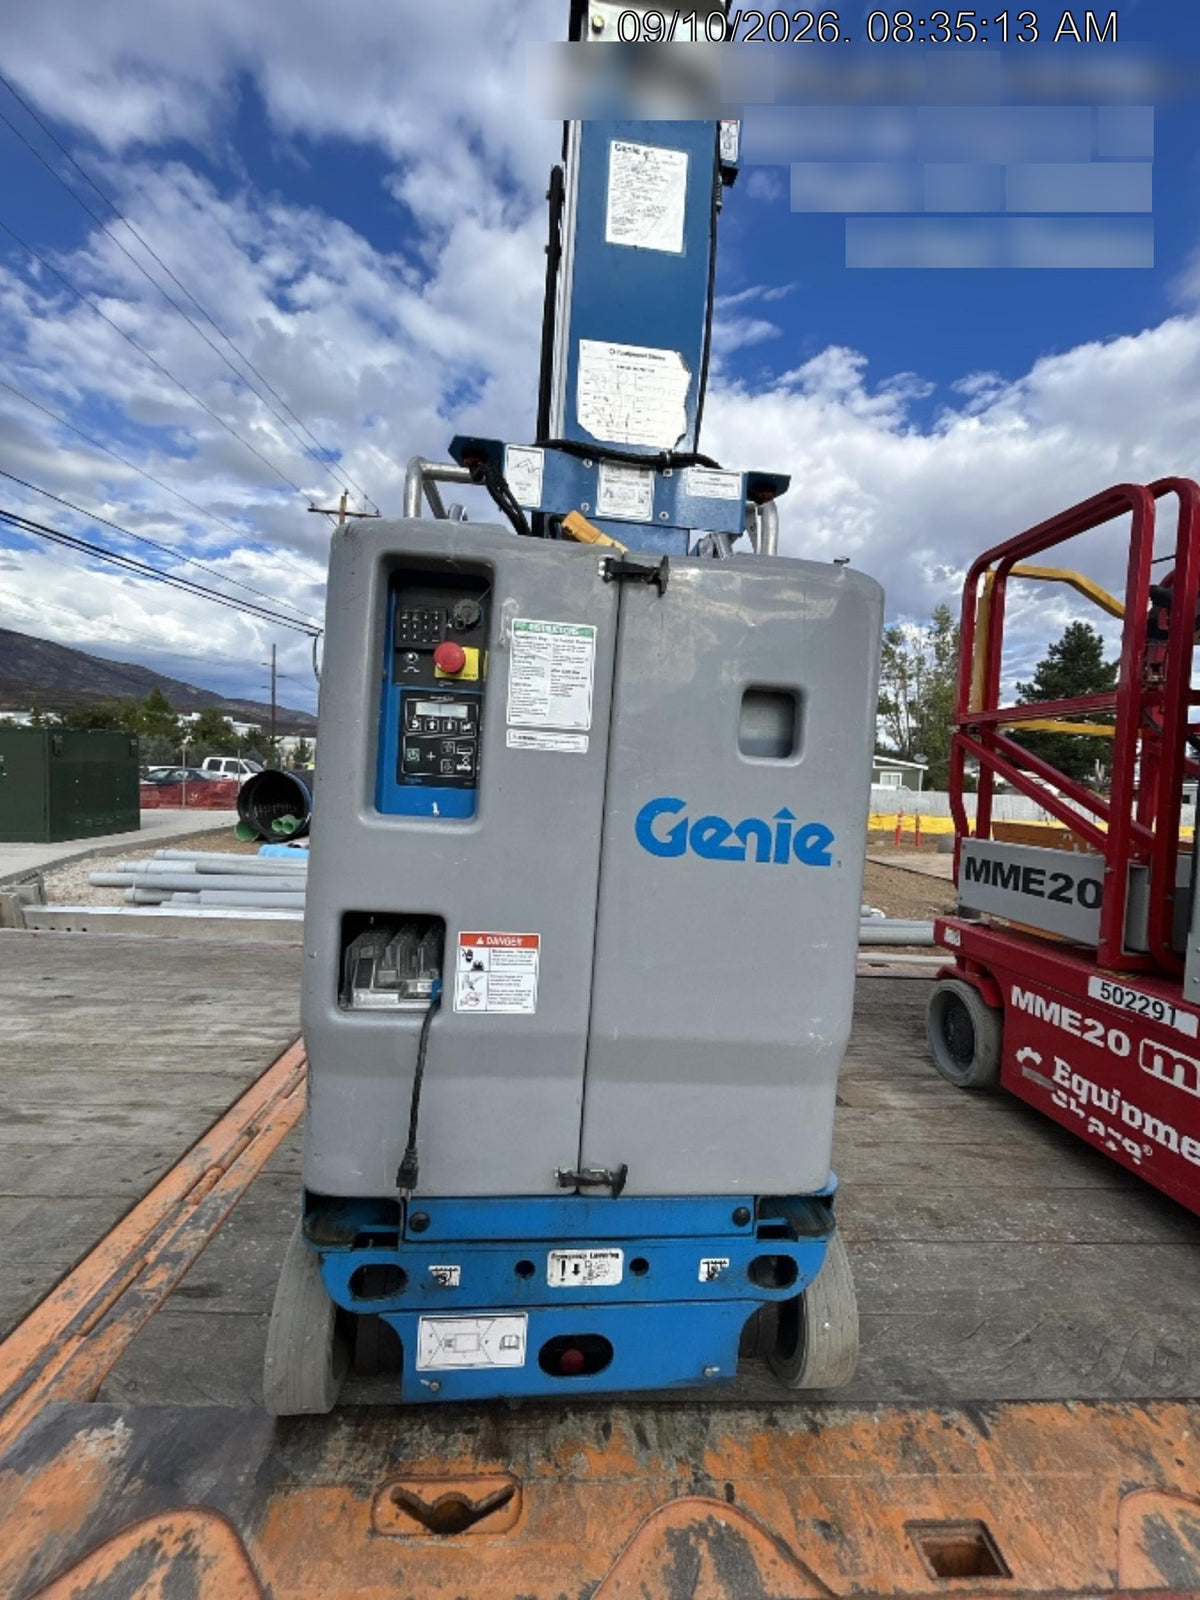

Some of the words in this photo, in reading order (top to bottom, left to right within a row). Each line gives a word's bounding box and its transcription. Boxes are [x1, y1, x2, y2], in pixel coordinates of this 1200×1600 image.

[635, 797, 835, 867] Genie
[964, 856, 1104, 910] MME20
[486, 936, 524, 947] DANGER
[1011, 984, 1131, 1058] MME20
[1100, 980, 1178, 1028] 502291
